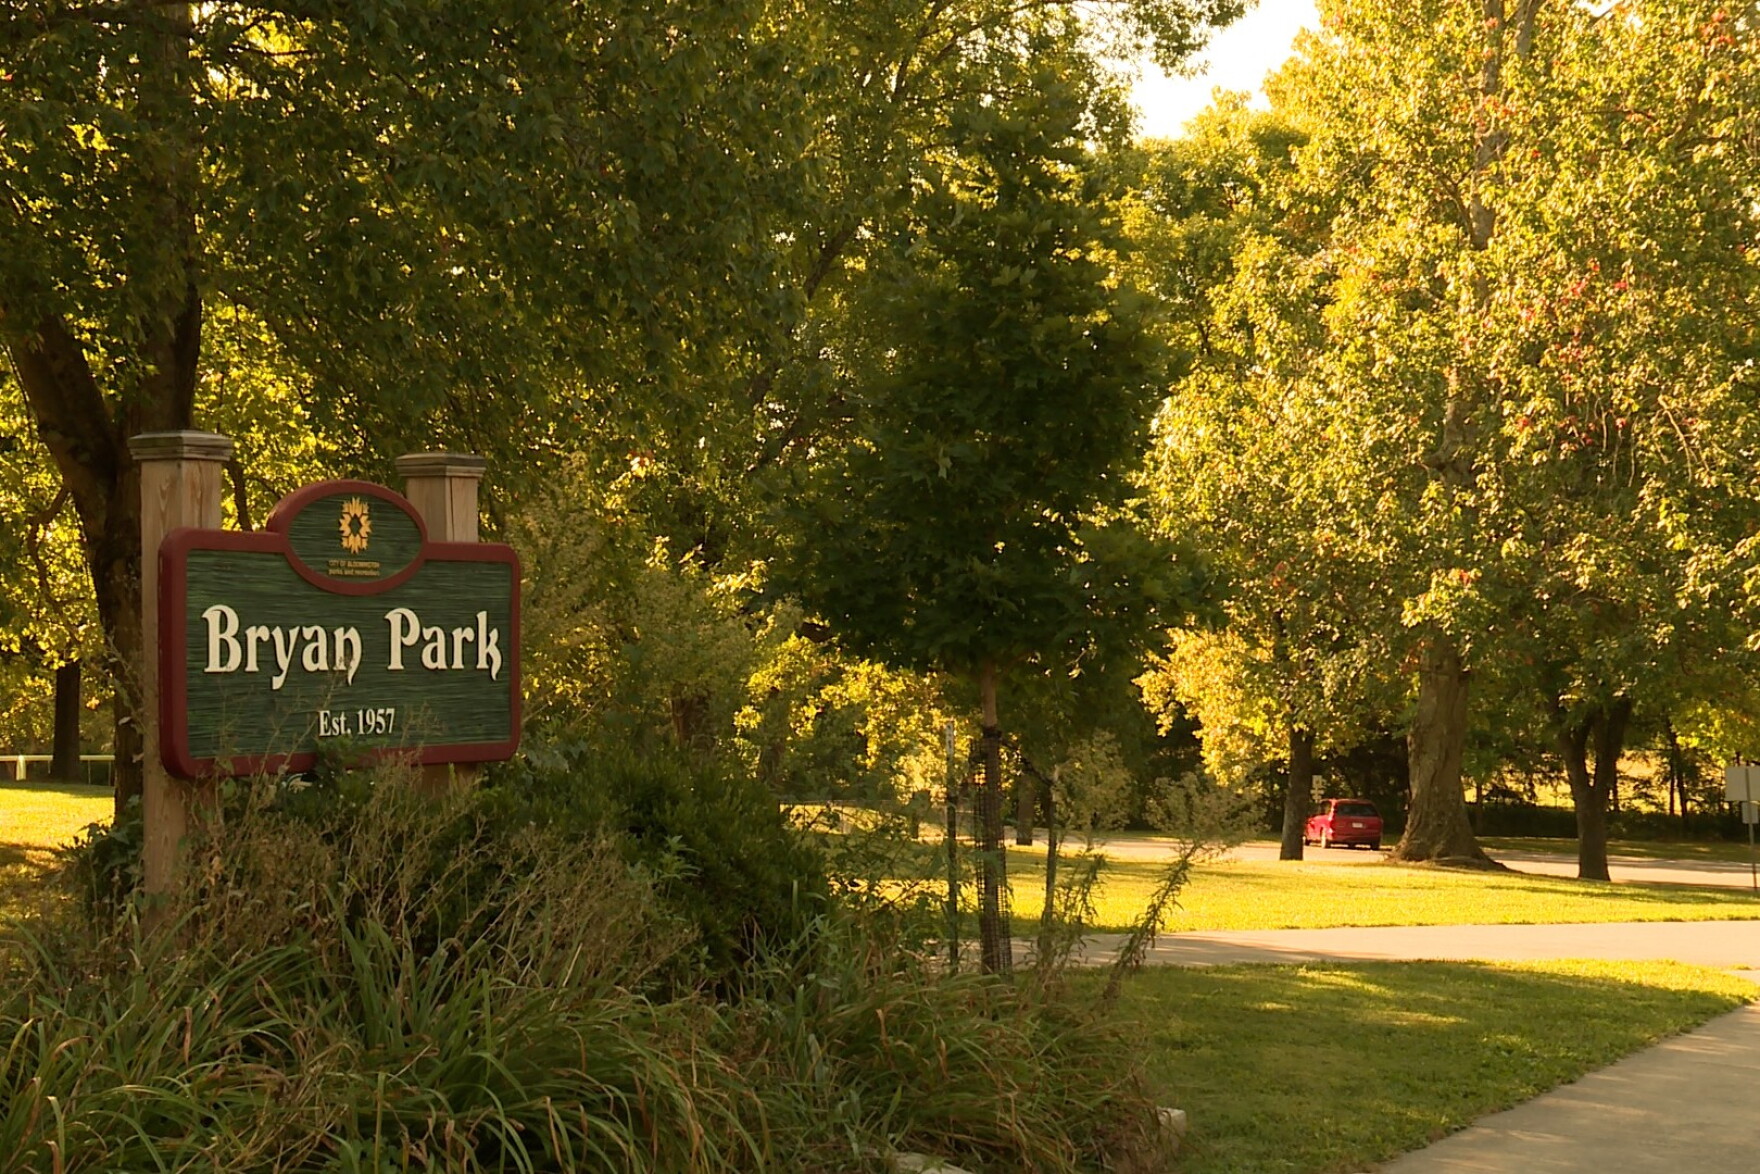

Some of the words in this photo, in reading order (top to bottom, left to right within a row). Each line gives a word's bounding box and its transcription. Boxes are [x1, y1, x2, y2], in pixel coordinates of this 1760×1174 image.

[202, 604, 362, 691] Bryan
[384, 607, 503, 681] Park
[319, 709, 352, 737] Est.
[357, 707, 395, 735] 1957
